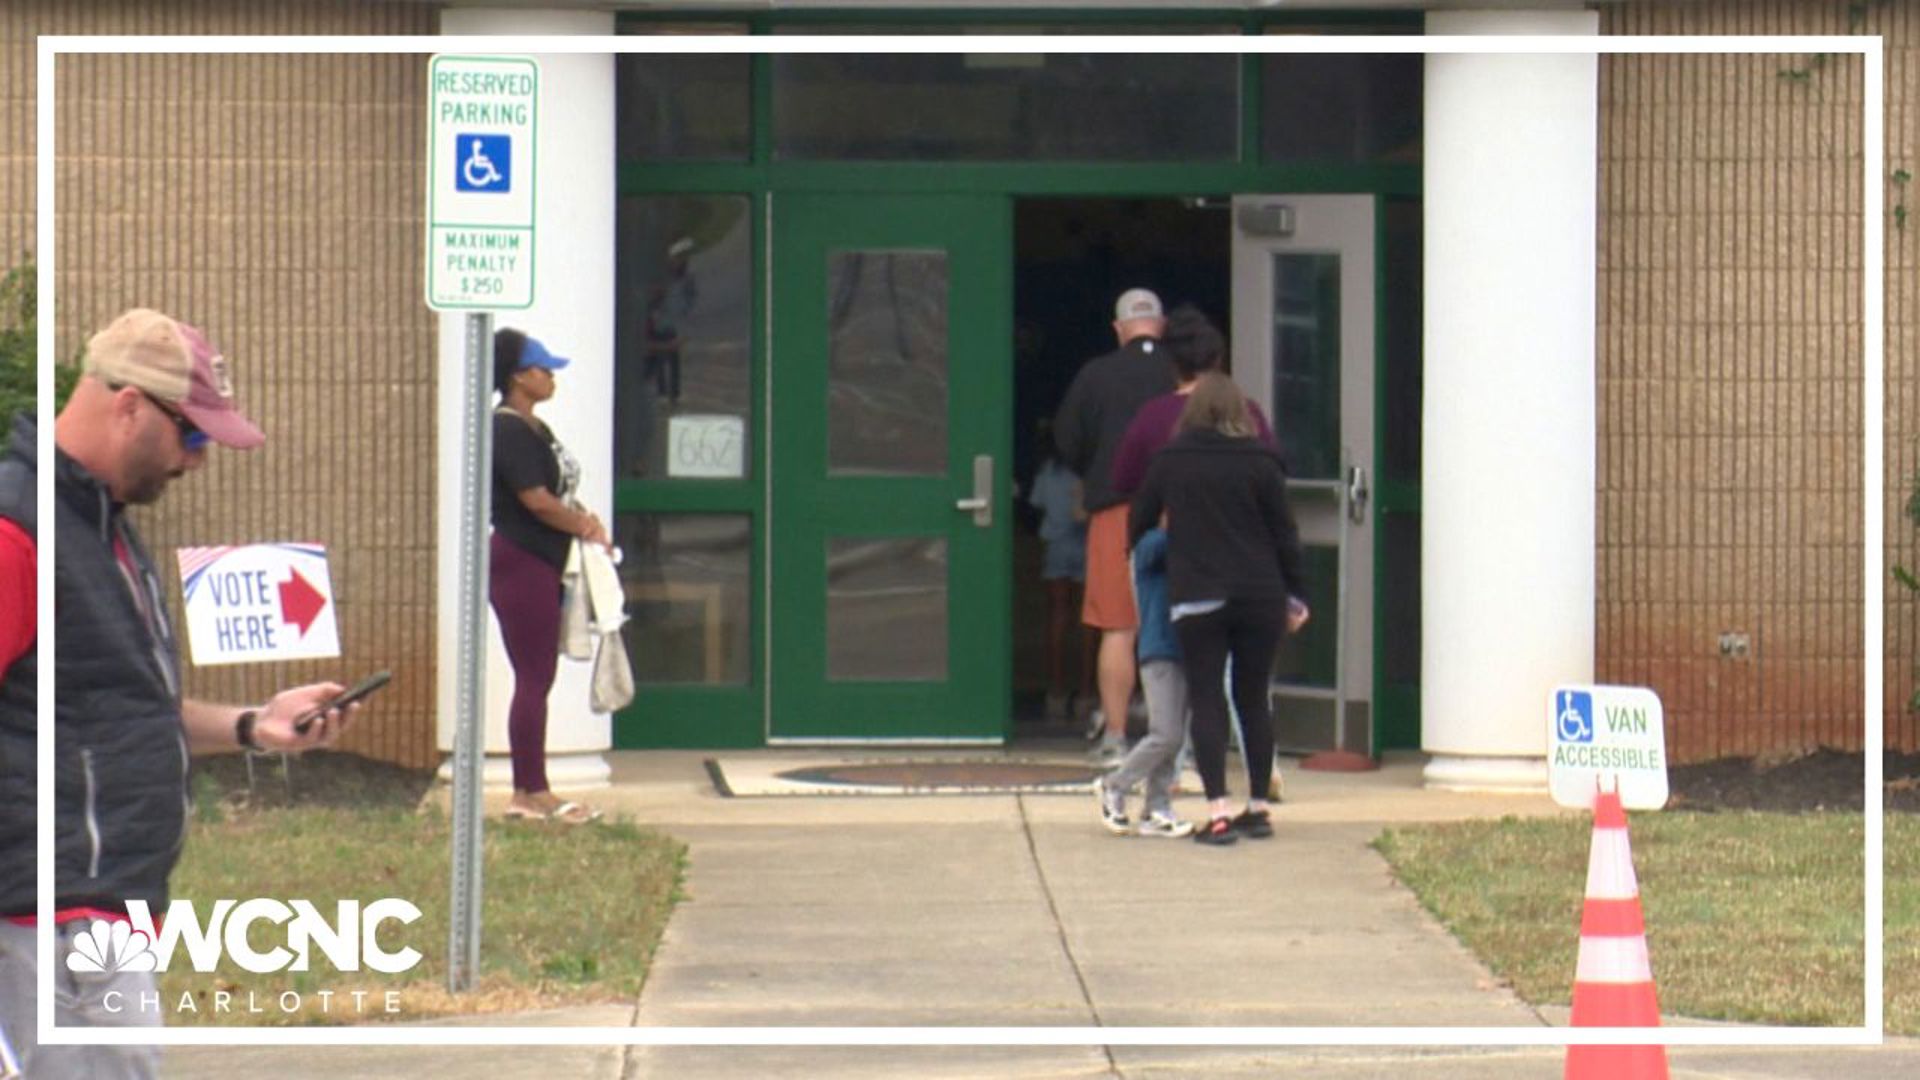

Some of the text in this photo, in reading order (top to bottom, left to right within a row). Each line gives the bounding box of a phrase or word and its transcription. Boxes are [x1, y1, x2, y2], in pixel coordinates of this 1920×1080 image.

[437, 71, 532, 96] RESERVED
[441, 101, 528, 126] PARKING
[445, 232, 520, 250] MAXIMUM
[446, 254, 517, 272] PENALTY
[461, 276, 504, 294] $250
[208, 570, 272, 607] VOTE
[215, 614, 278, 652] HERE
[1604, 705, 1648, 734] VAN
[1554, 743, 1660, 770] ACCESSIBLE
